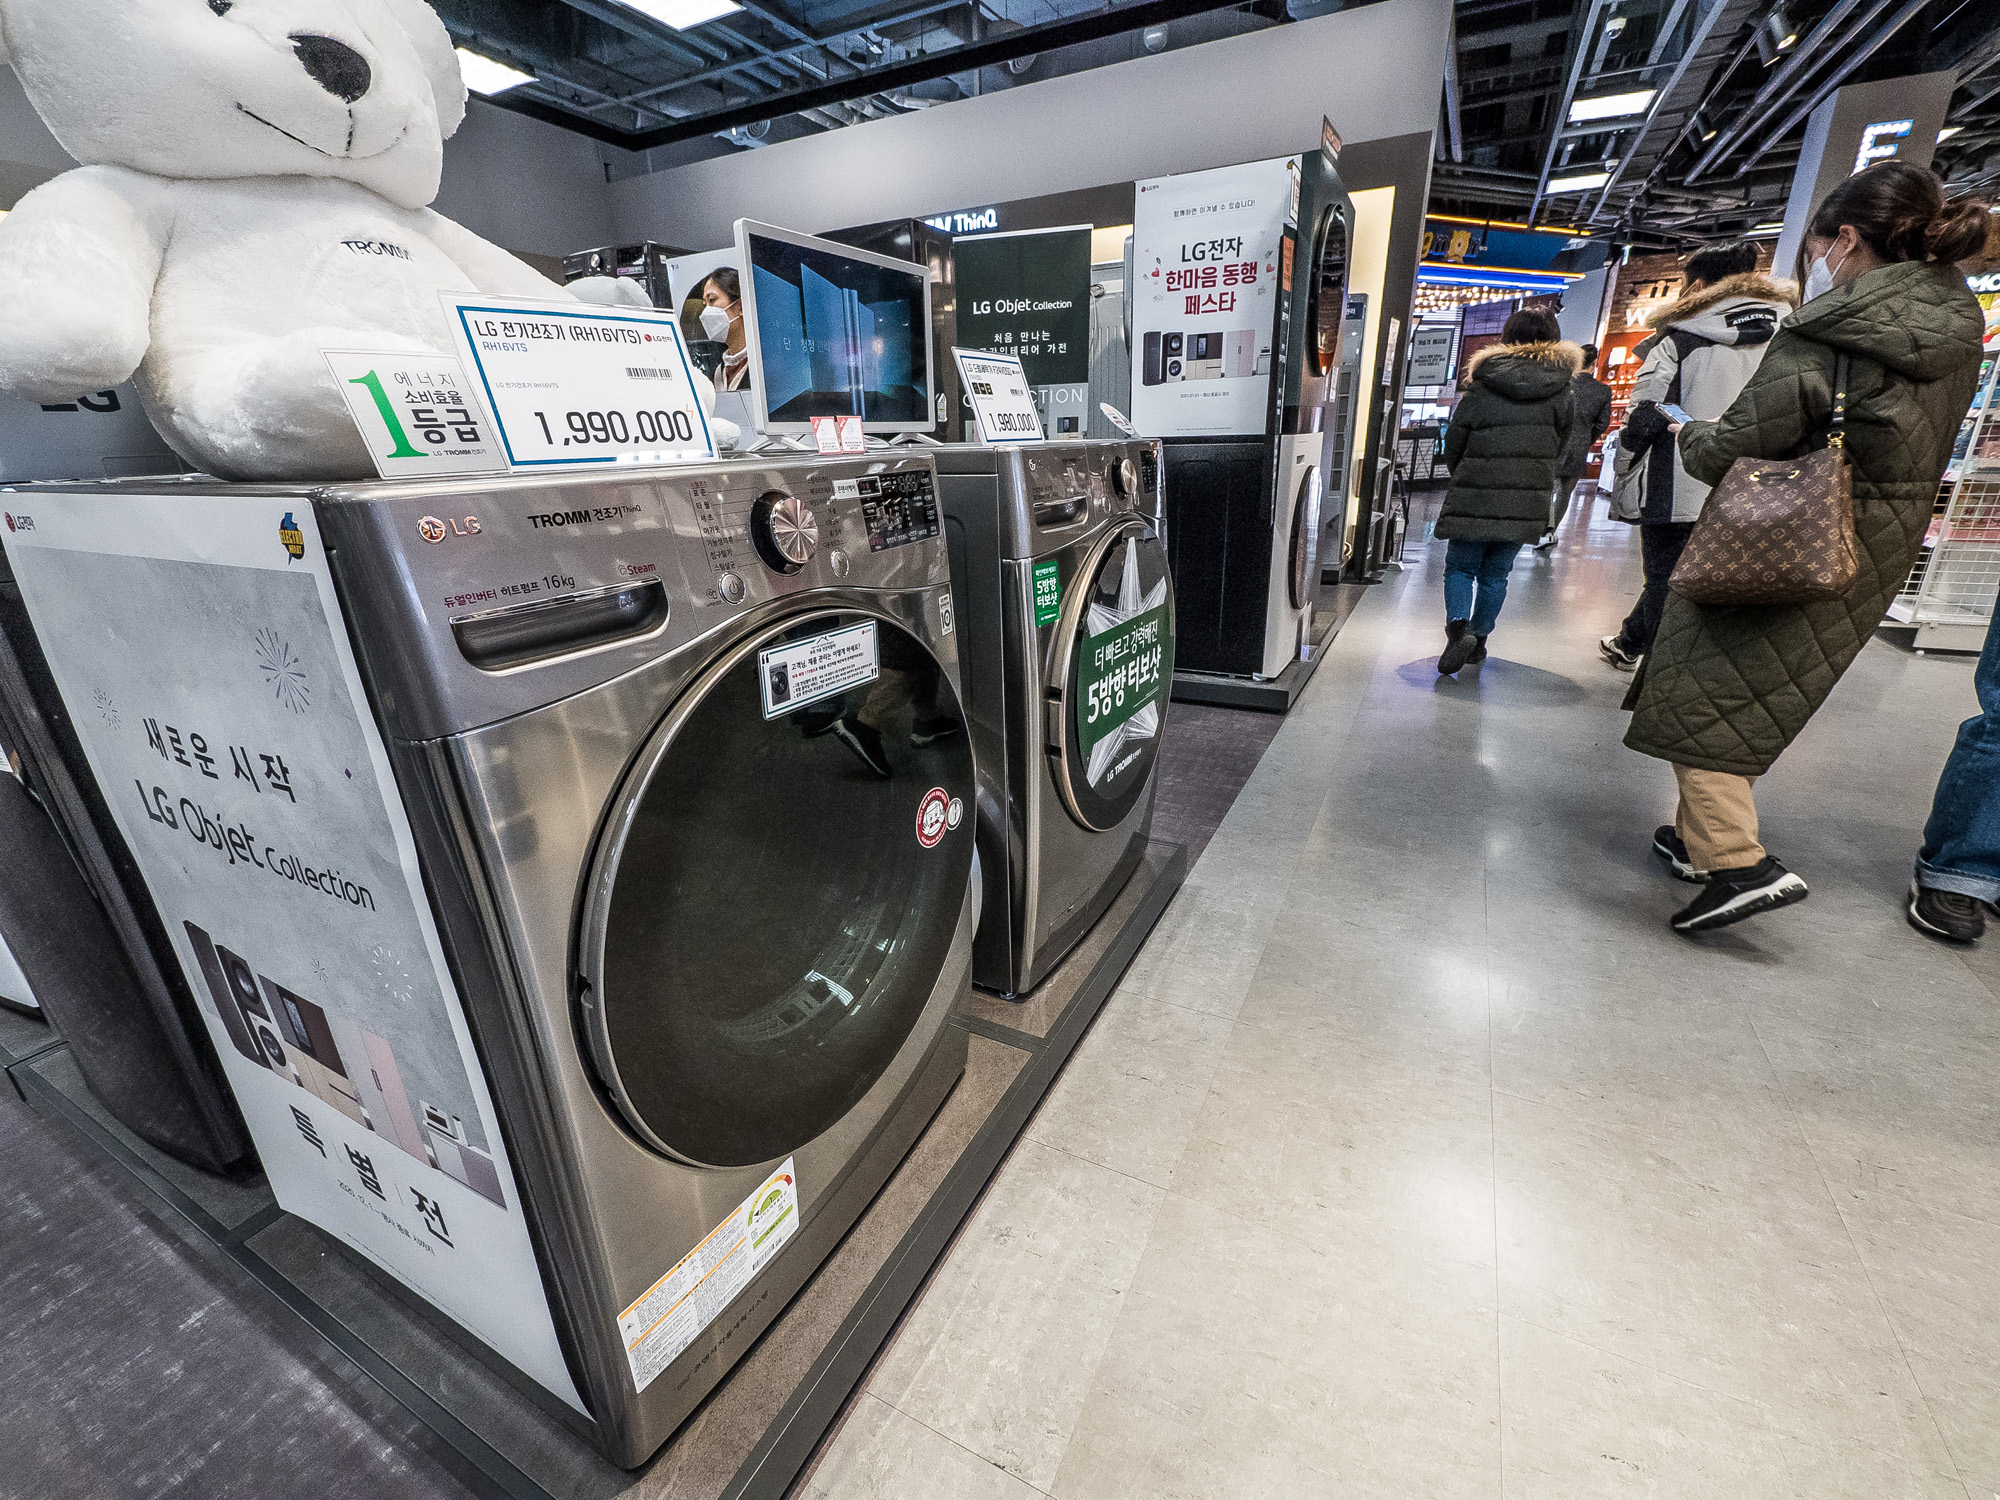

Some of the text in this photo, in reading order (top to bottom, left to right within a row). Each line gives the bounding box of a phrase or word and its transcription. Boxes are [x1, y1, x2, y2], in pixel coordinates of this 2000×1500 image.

[954, 208, 998, 232] ThinQ
[1174, 208, 1197, 218] 함께하면
[1200, 204, 1218, 214] 이겨낼
[1228, 199, 1255, 209] 있습니다!
[340, 240, 414, 261] TROMM
[1181, 236, 1243, 262] LG전자
[1166, 266, 1218, 292] 한마음
[1222, 261, 1258, 287] 동행
[973, 298, 1072, 315] LG Objet Collection
[1184, 291, 1237, 315] 페스타
[474, 319, 498, 337] LG
[500, 321, 566, 341] 전기건조기
[569, 324, 642, 345] (RH16VTS)
[994, 330, 1051, 344] 처음 만나는
[483, 341, 528, 353] RH16VTS
[1047, 342, 1067, 354] 가전
[394, 371, 456, 388] 에너지
[404, 390, 465, 406] 소비효율
[348, 369, 429, 459] 1
[989, 413, 1036, 433] 1,980,000
[411, 408, 482, 445] 등급
[534, 410, 693, 446] 1,990,000
[449, 504, 642, 537] LG TROMM 건조기 ThinQ
[627, 562, 656, 576] Steam
[443, 575, 576, 609] 듀얼인버터 히트펌프 16kg
[1037, 577, 1057, 594] 5방향
[1037, 591, 1058, 609] 터보샷
[1094, 618, 1159, 672] 더 빠르고 강력해진
[1087, 643, 1162, 724] 5방향 터보샷
[142, 717, 297, 804] 새로운 시작
[1107, 769, 1114, 783] LG
[134, 778, 376, 913] LG Objet Collection
